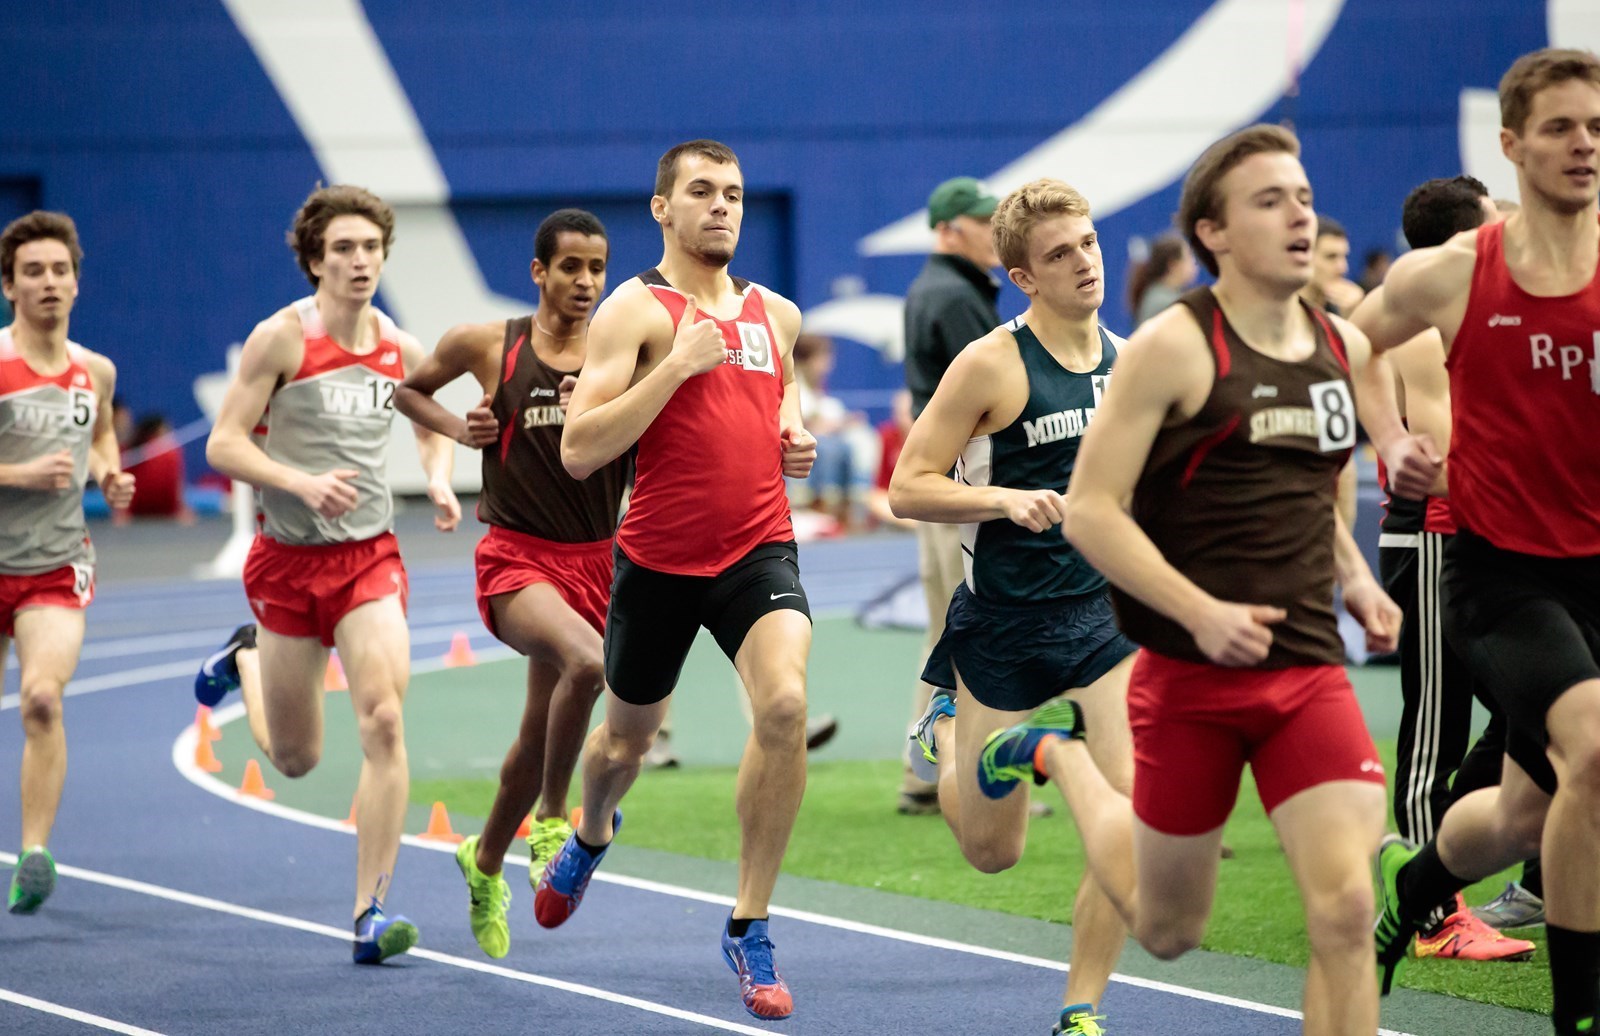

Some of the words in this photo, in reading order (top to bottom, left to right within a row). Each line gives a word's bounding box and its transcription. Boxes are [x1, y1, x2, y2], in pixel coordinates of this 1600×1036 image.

[743, 326, 769, 368] 9
[1529, 333, 1600, 393] RP
[73, 392, 90, 426] 5
[368, 380, 396, 411] 12
[13, 403, 73, 437] WP
[1321, 388, 1349, 442] 8
